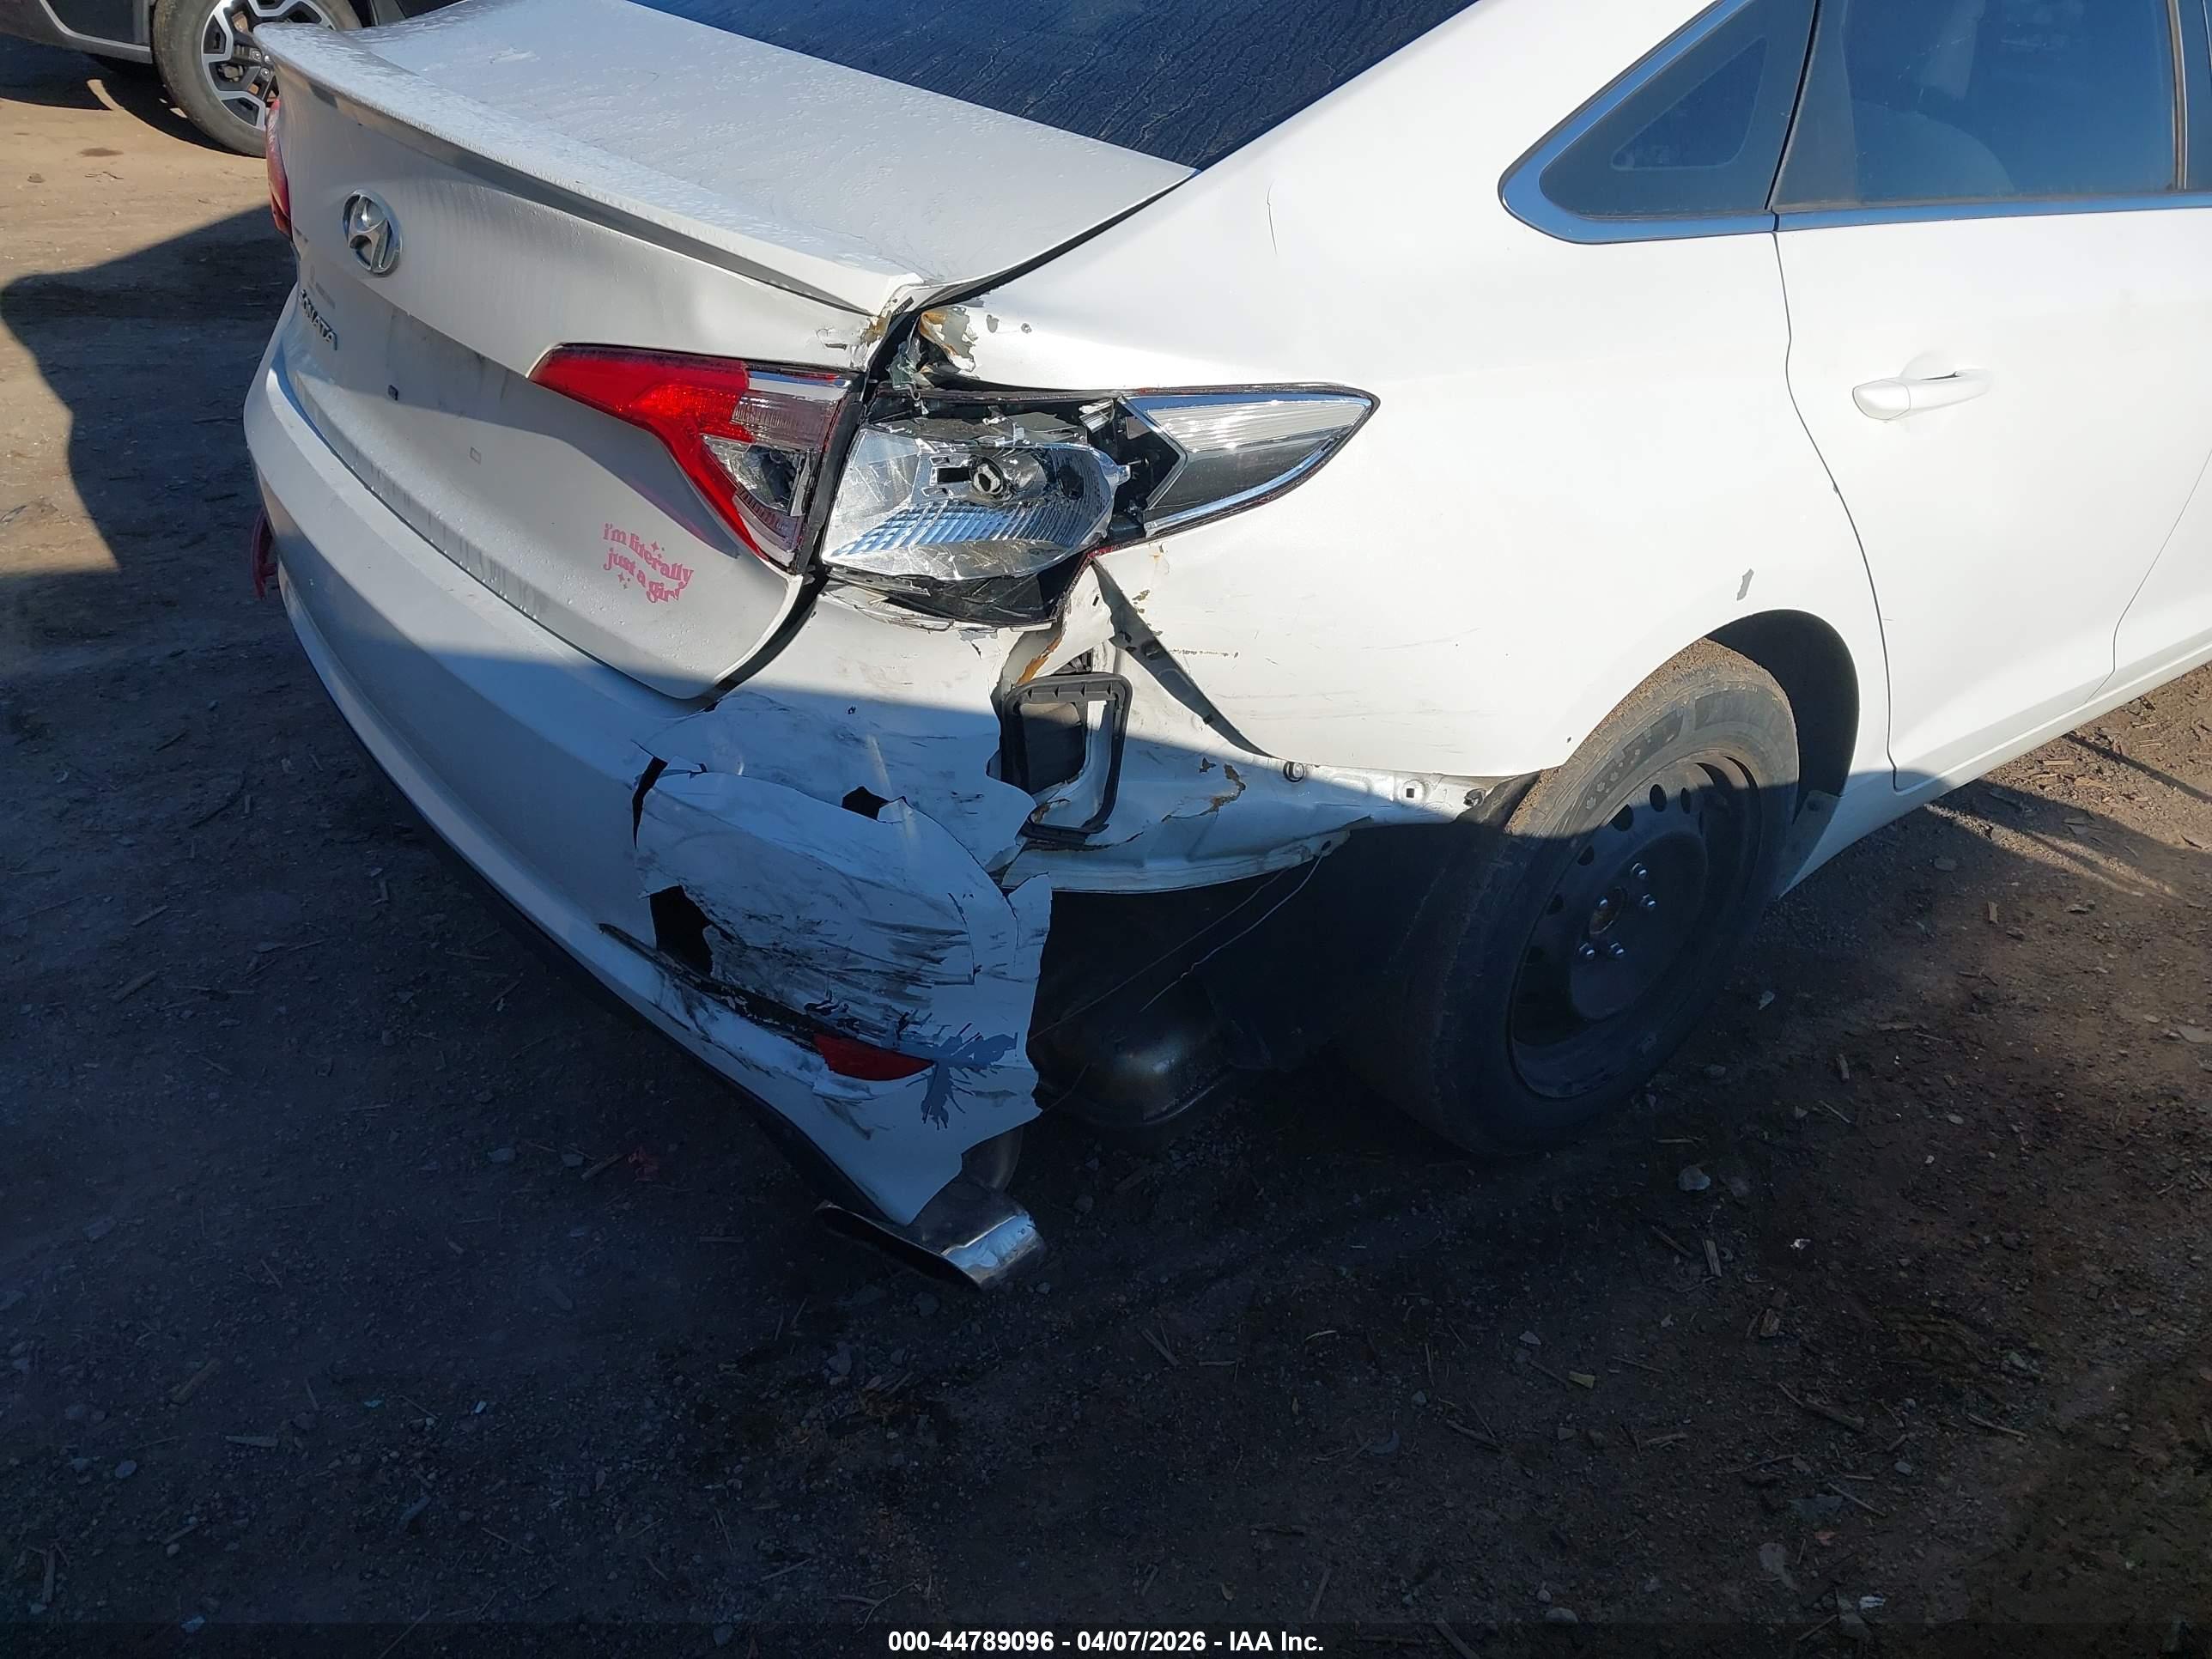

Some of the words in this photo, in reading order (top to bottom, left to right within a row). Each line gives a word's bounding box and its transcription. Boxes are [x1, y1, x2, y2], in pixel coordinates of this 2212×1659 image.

[603, 547, 636, 577] just
[636, 569, 646, 587] a
[646, 580, 682, 604] girl
[629, 532, 694, 590] literally
